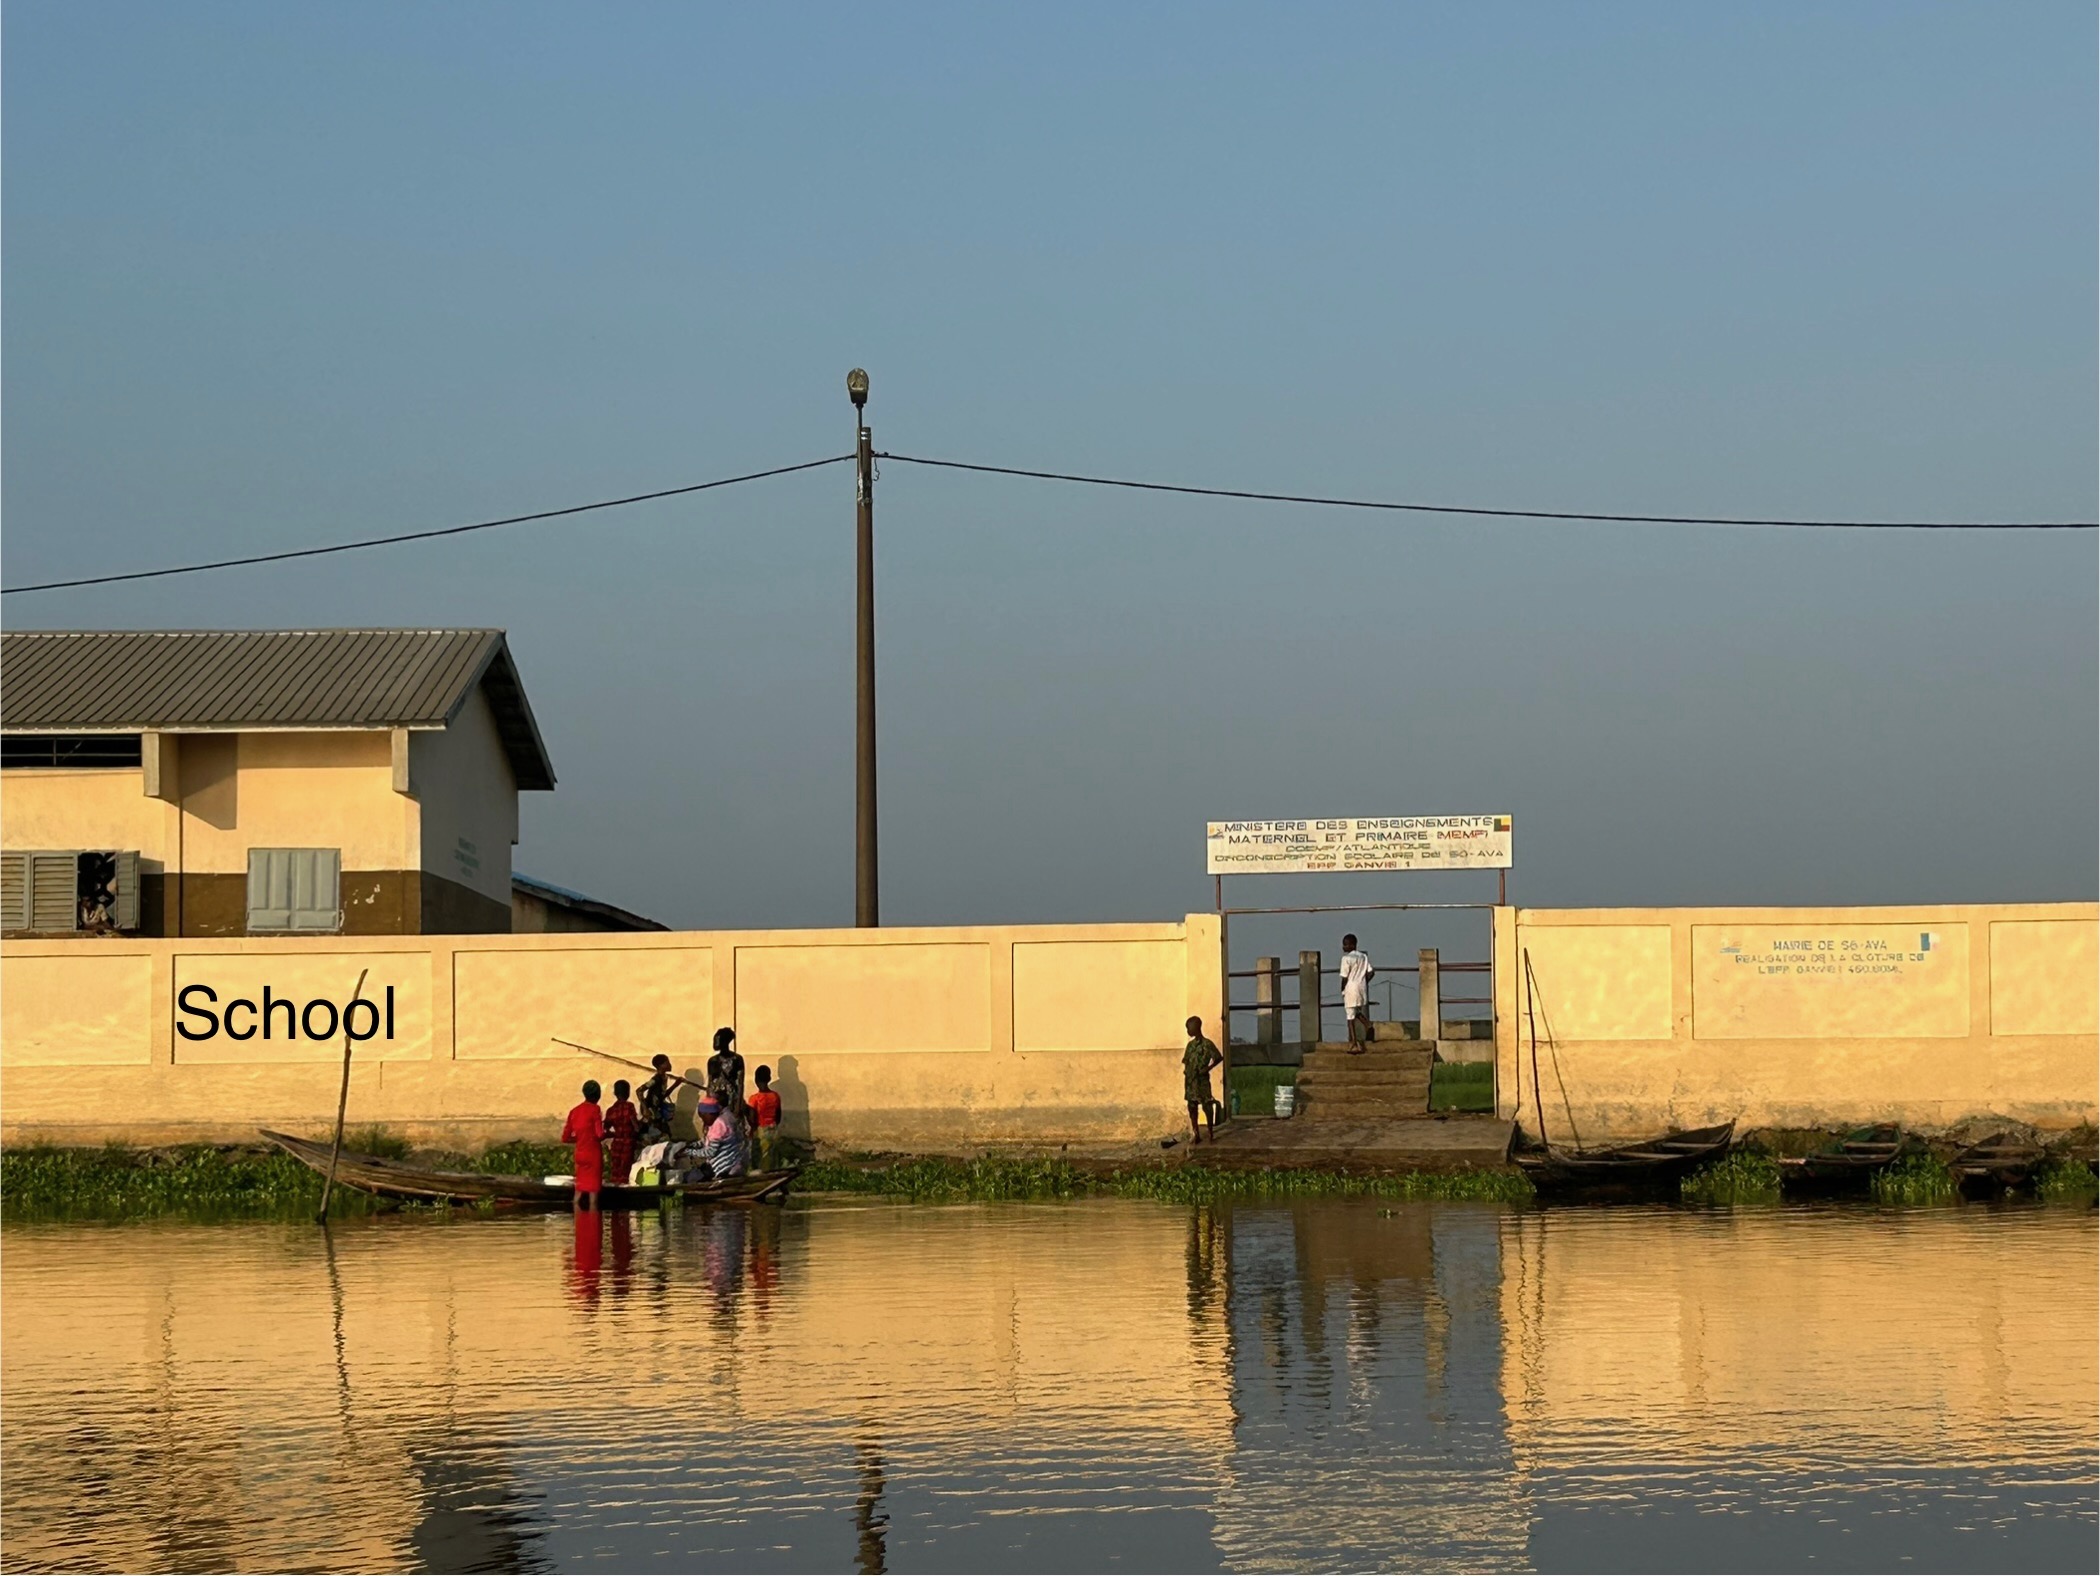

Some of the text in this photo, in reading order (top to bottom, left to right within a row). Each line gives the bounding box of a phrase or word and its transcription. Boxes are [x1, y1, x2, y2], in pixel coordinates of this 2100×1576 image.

[1224, 817, 1493, 833] MINISTERE DES ENSEIGNEMENTS
[1228, 834, 1317, 845] MATERNEL
[1325, 833, 1346, 843] ET
[1355, 831, 1428, 842] PRIMAIRE
[1344, 851, 1414, 861] SCOLAIRE
[1773, 940, 1812, 951] MAIRIE
[1817, 940, 1835, 951] DE
